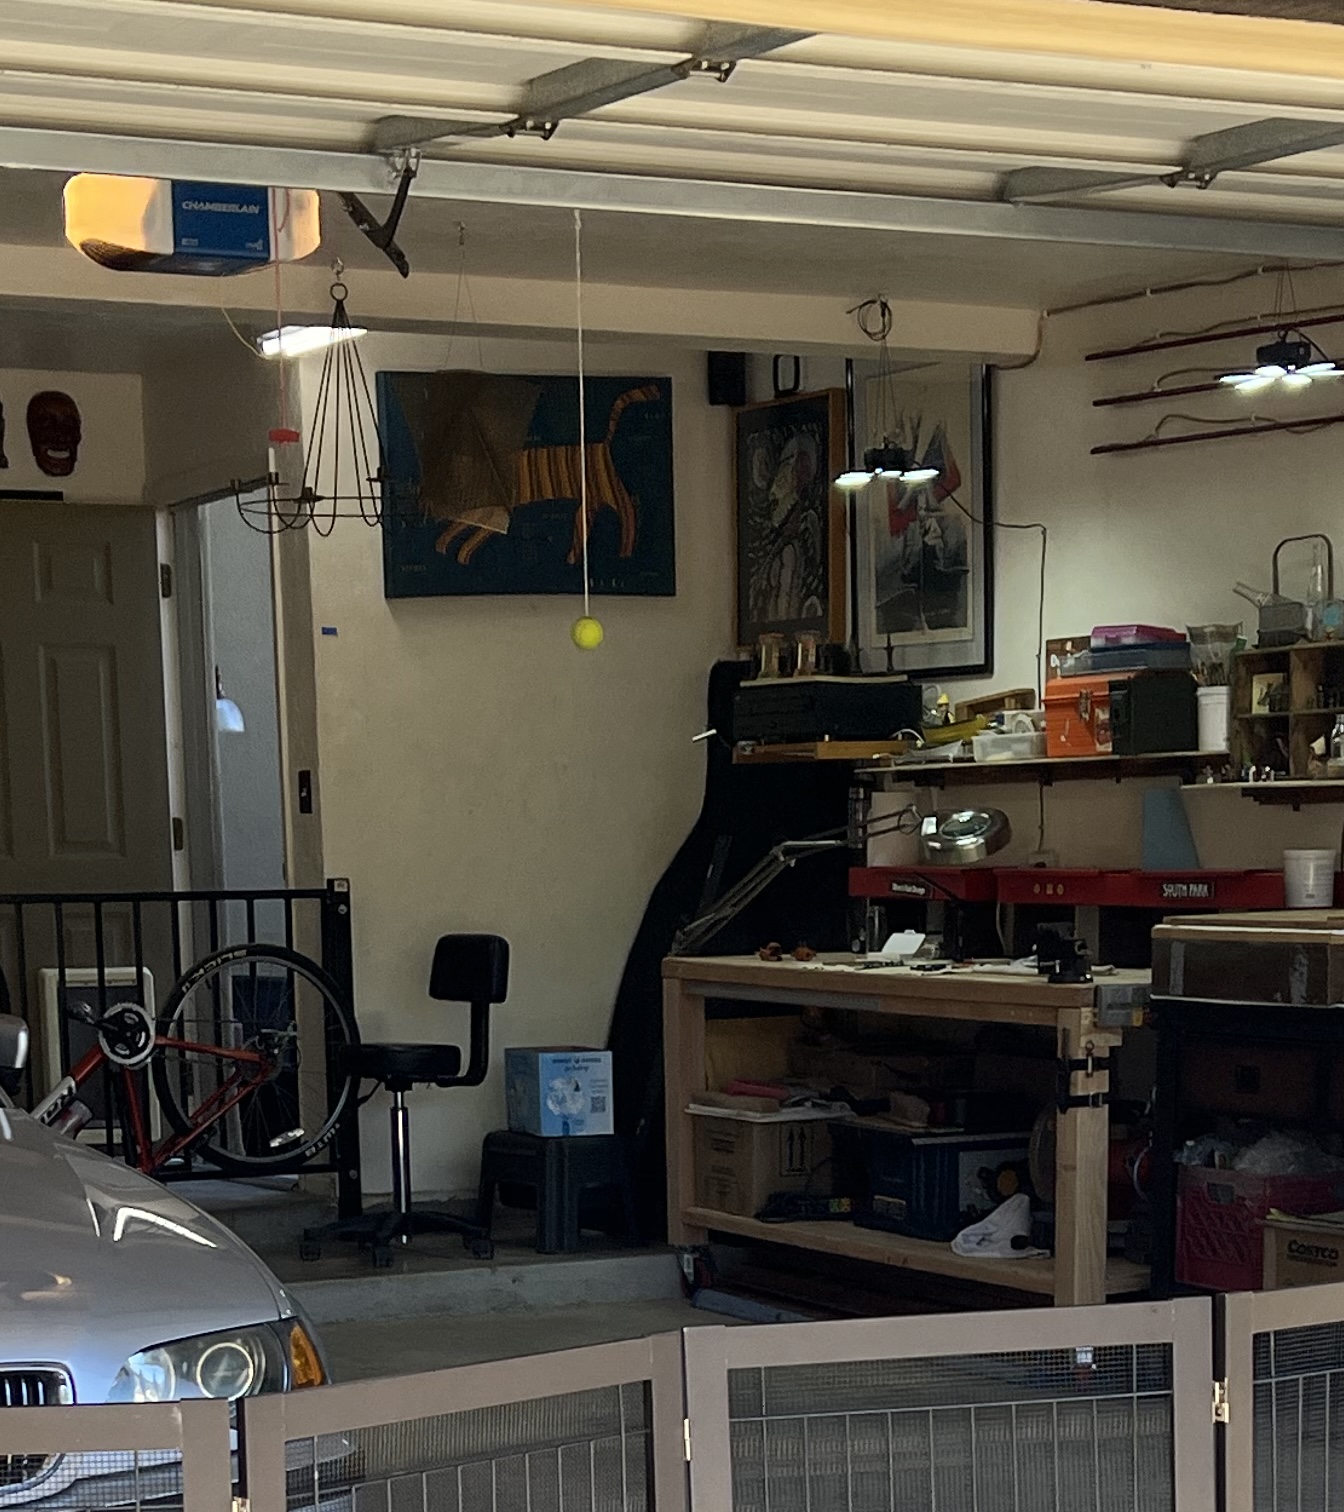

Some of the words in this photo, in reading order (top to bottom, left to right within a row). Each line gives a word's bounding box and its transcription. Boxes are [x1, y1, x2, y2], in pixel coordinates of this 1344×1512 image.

[182, 200, 260, 215] CHAMBERLAIN
[1162, 883, 1188, 898] SOUTH
[1189, 883, 1209, 898] PARK
